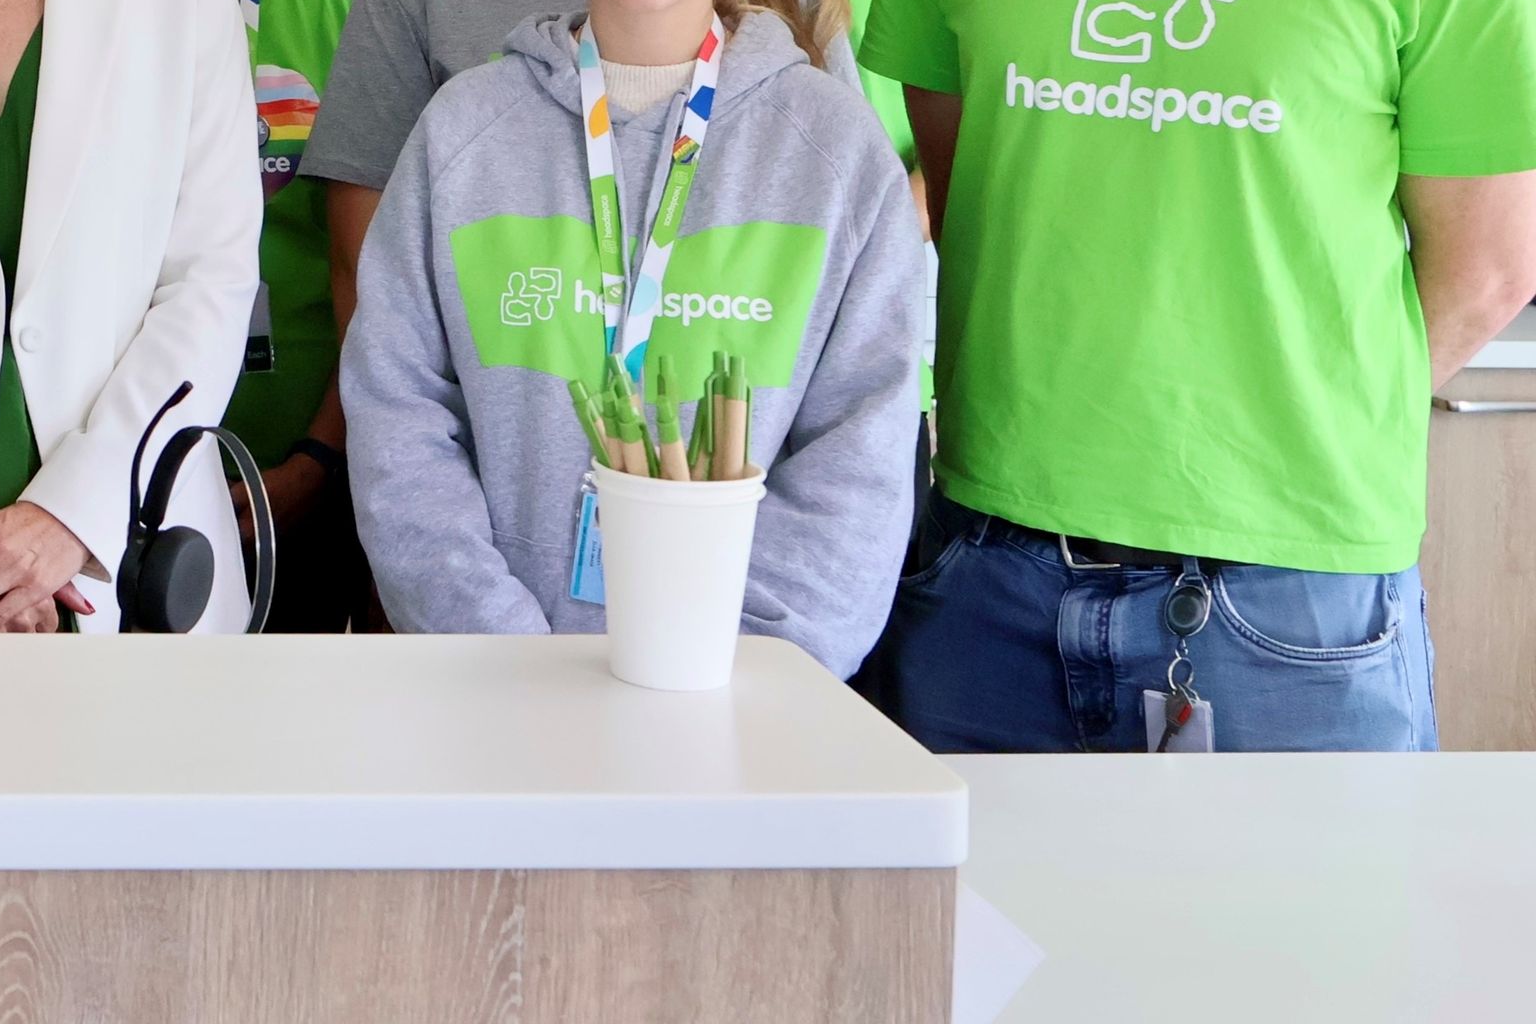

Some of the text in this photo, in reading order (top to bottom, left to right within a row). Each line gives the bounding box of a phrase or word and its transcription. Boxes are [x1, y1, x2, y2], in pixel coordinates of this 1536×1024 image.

[1006, 63, 1282, 133] headspace
[602, 195, 612, 238] headspace
[664, 186, 682, 225] headspace
[574, 279, 773, 327] hspace
